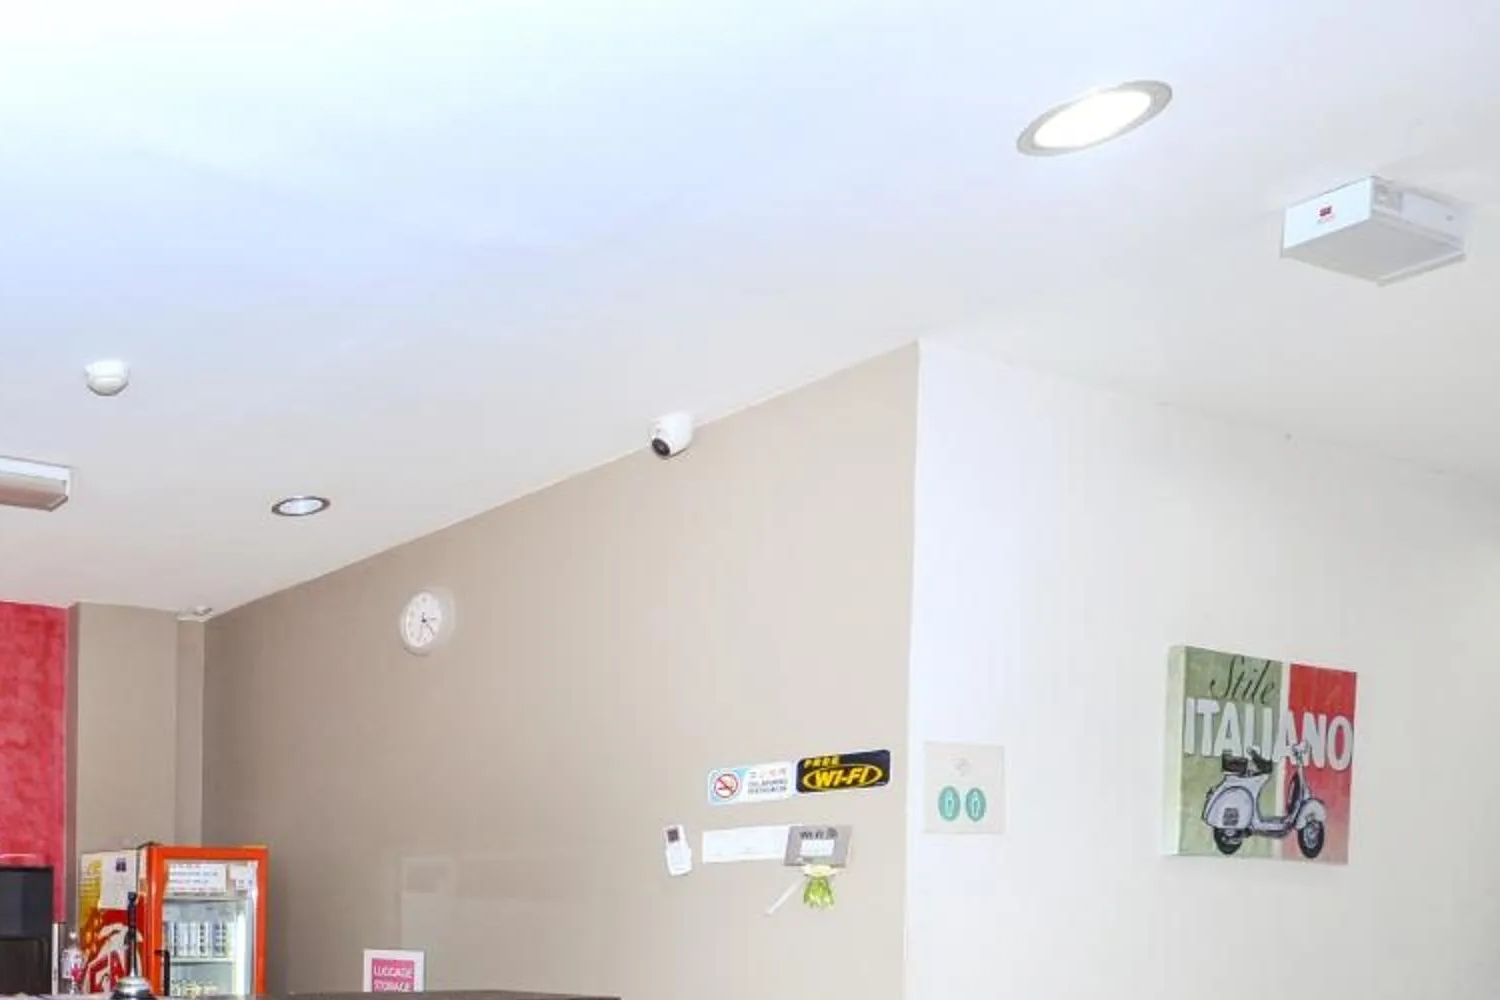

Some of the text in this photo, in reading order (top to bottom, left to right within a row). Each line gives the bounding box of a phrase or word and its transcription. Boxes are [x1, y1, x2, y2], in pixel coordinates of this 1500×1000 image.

[1209, 656, 1275, 704] Stile
[1183, 697, 1354, 771] ITALIANO
[815, 766, 869, 787] WI-FI
